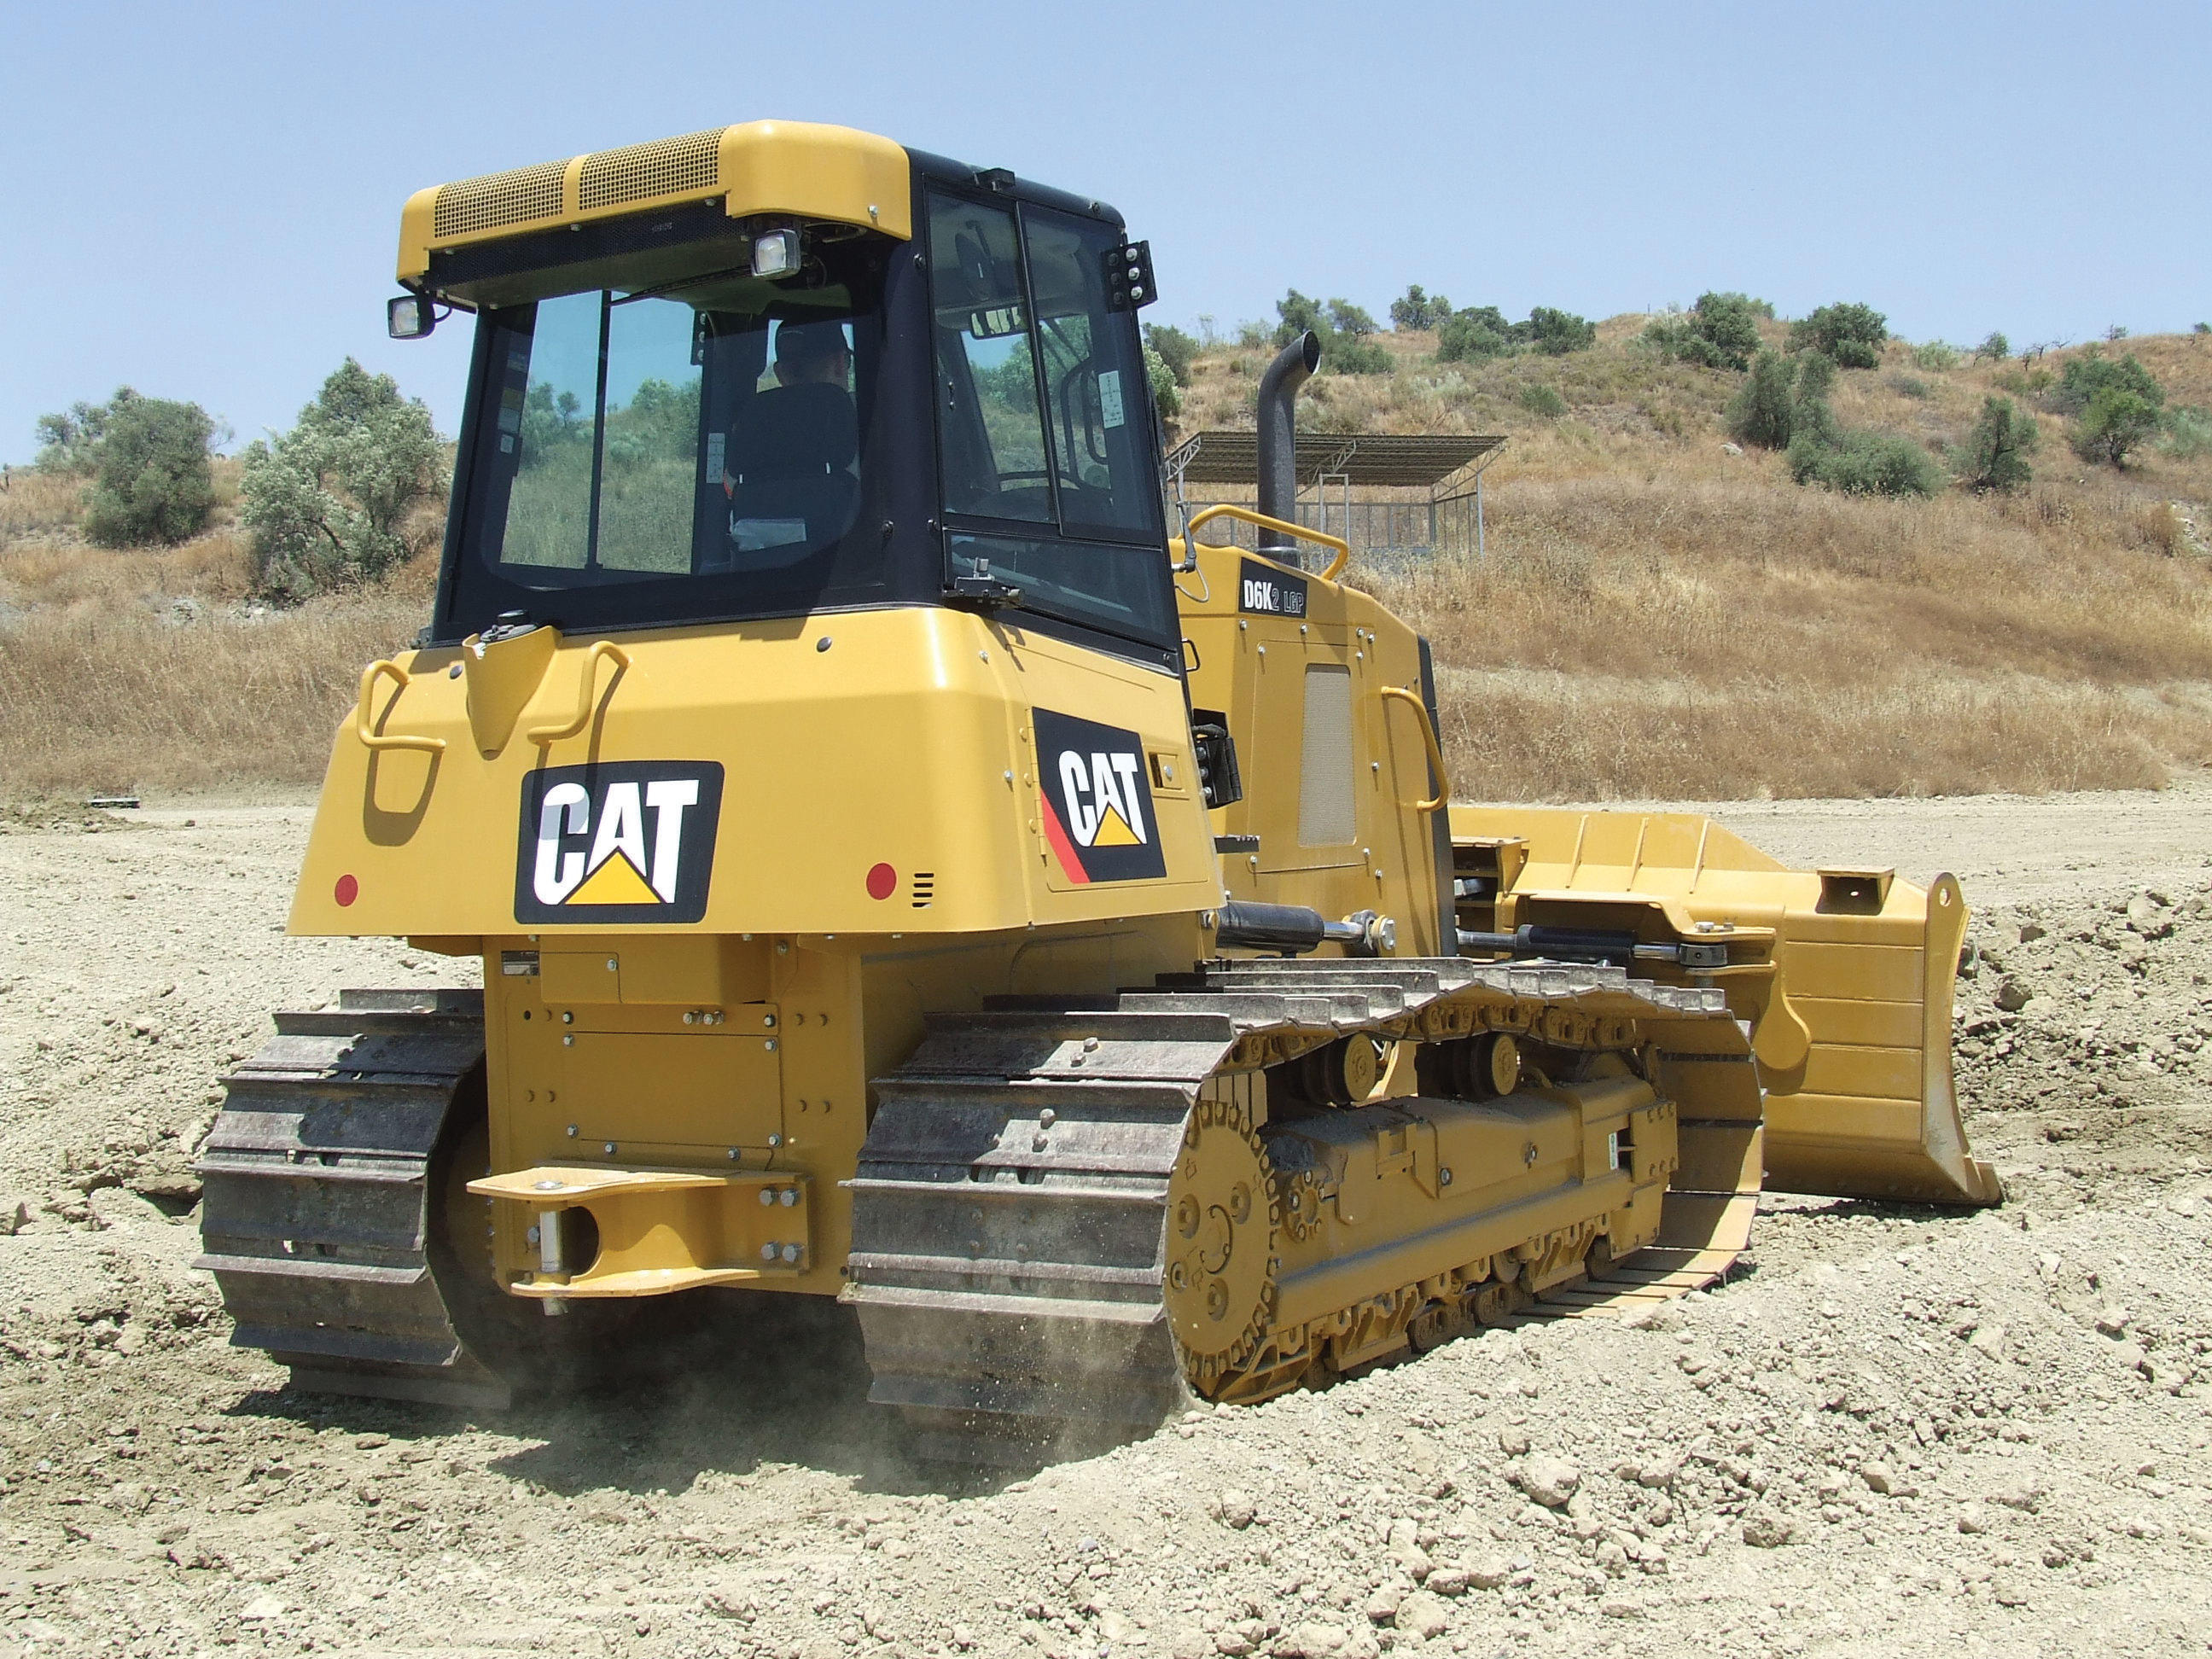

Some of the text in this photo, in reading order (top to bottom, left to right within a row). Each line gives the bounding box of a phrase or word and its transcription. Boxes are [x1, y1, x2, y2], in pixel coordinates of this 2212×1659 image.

[1243, 579, 1304, 614] D6K2 LGP
[533, 779, 700, 905] CAT
[1058, 750, 1148, 847] CAT
